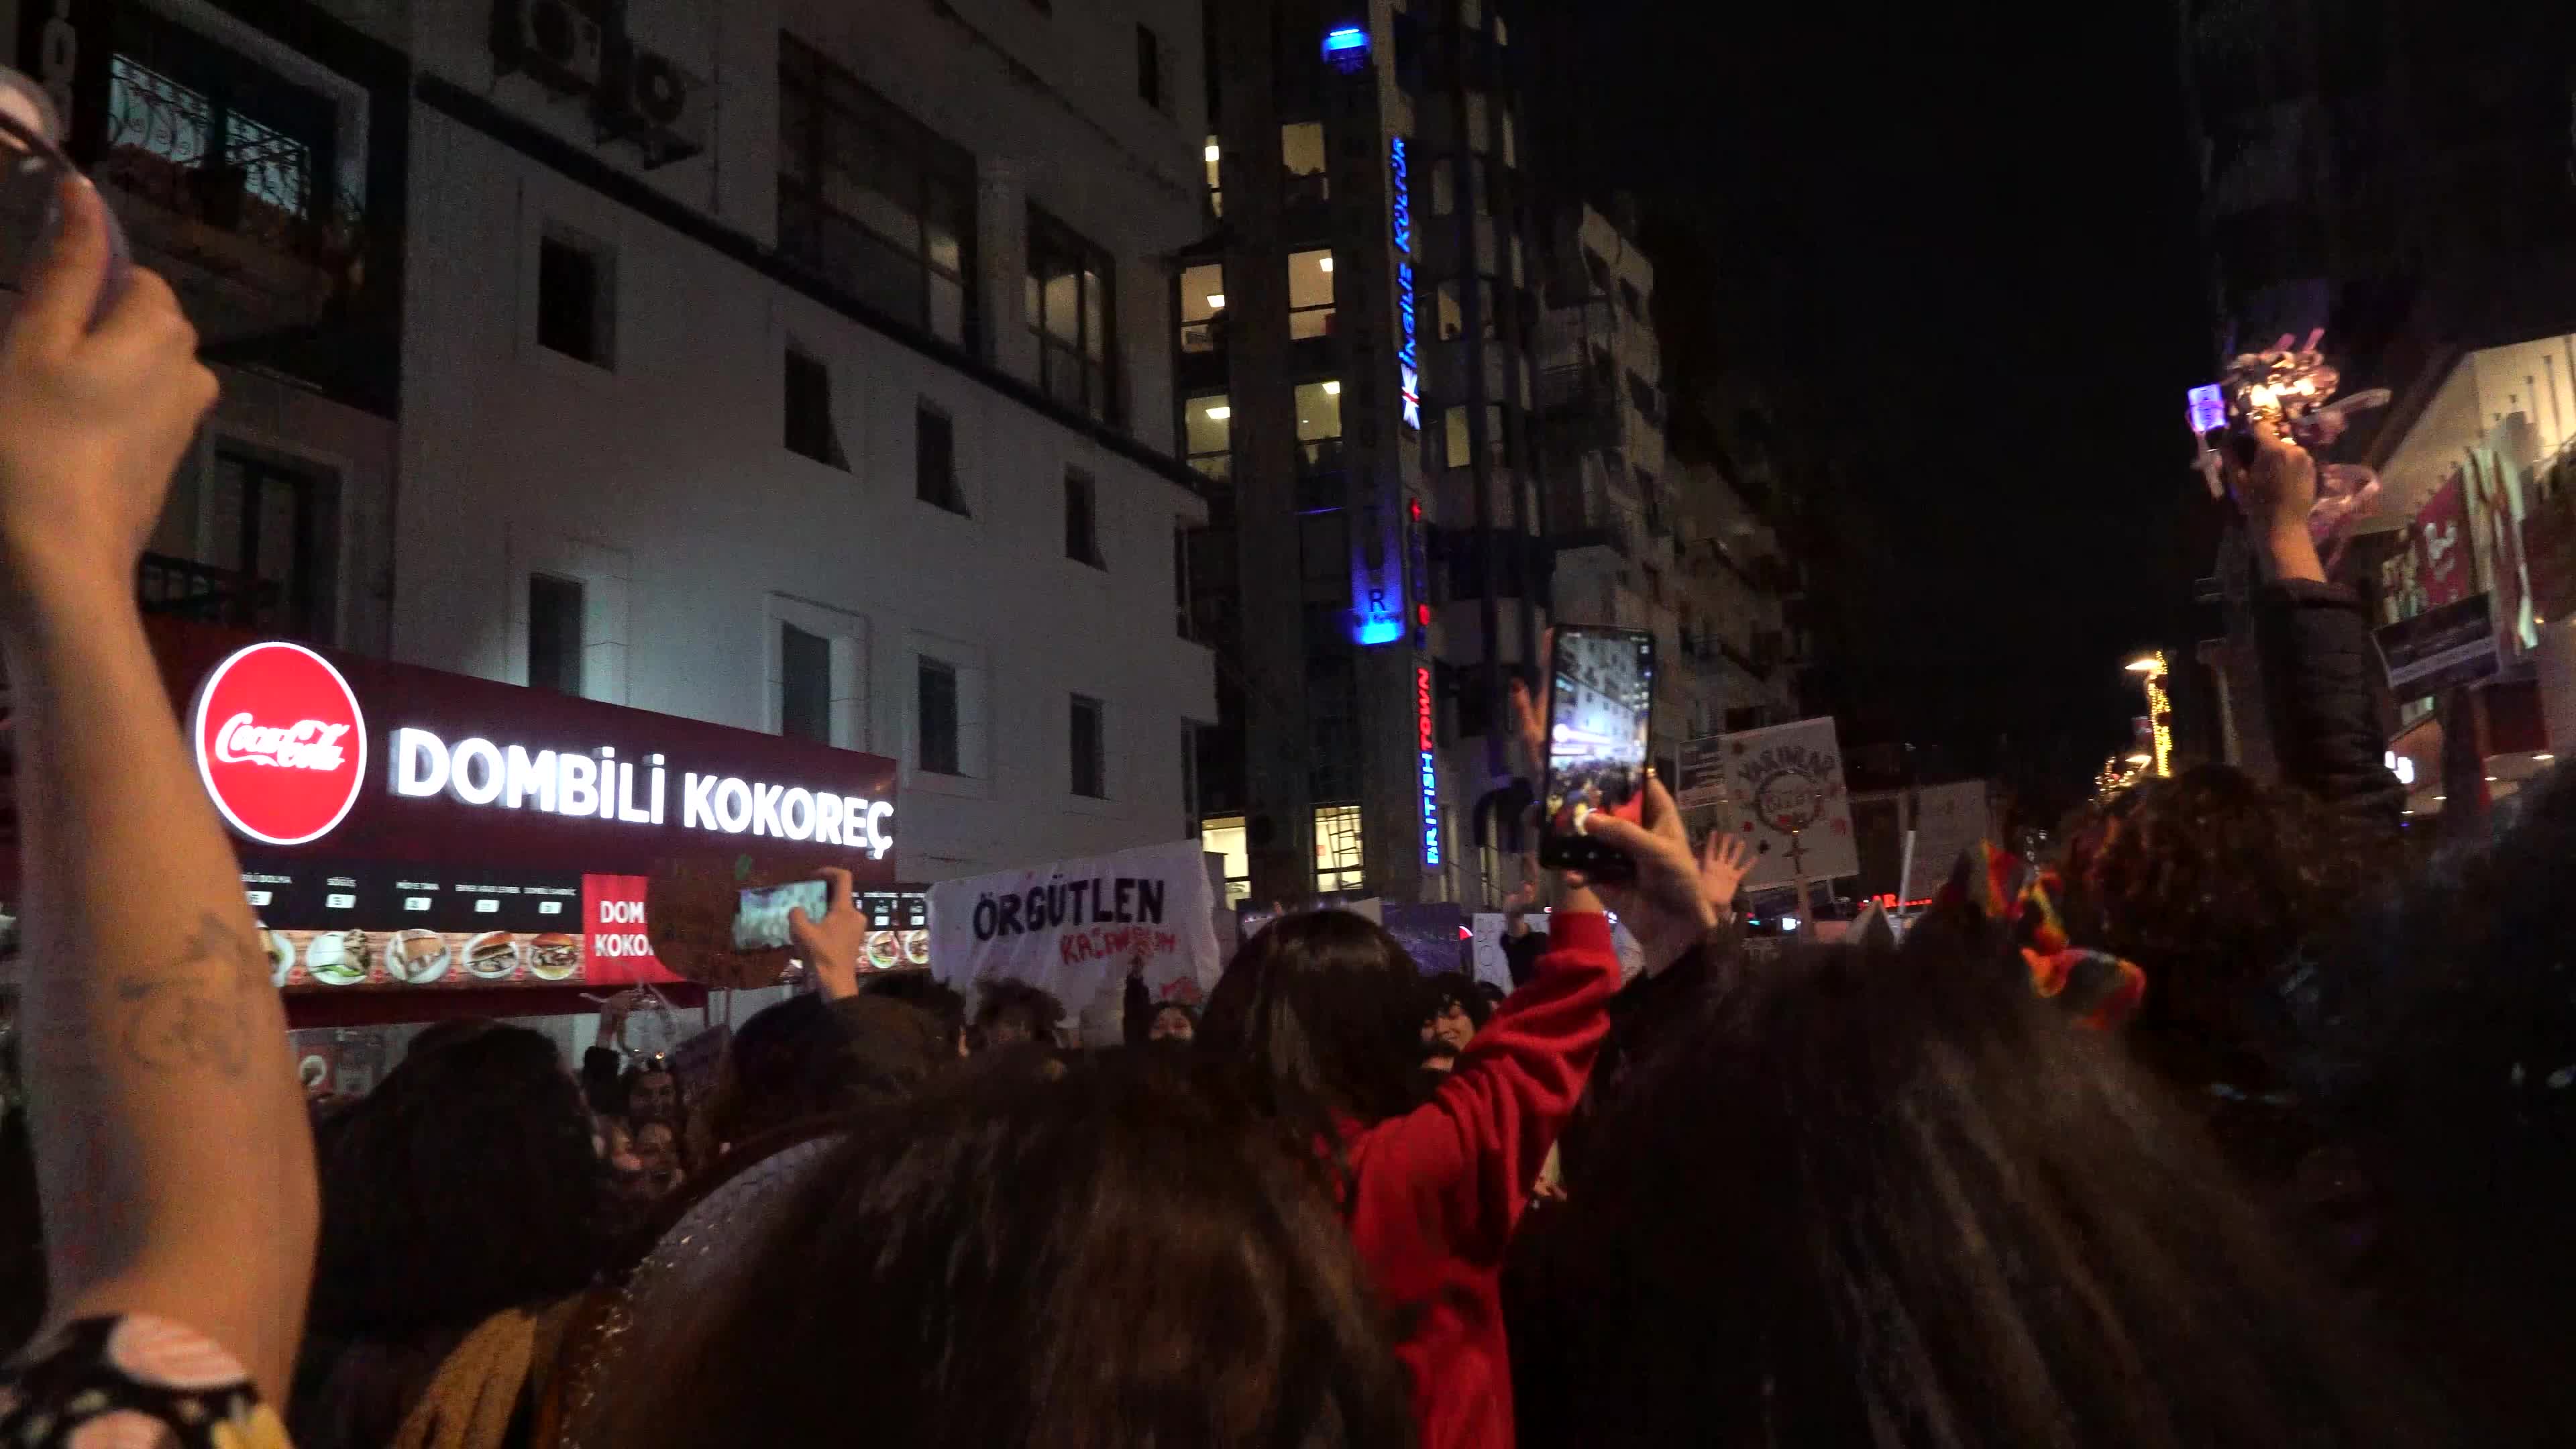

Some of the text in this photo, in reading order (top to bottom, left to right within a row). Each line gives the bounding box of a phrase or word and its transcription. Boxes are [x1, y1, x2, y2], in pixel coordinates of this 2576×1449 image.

[1391, 138, 1411, 253] KÜLTÜR
[391, 727, 894, 861] DOMBİLİ KOKOREÇ
[600, 900, 645, 924] DOM
[973, 873, 1165, 941] ÖRGÜTLEN
[594, 933, 655, 957] KOKO
